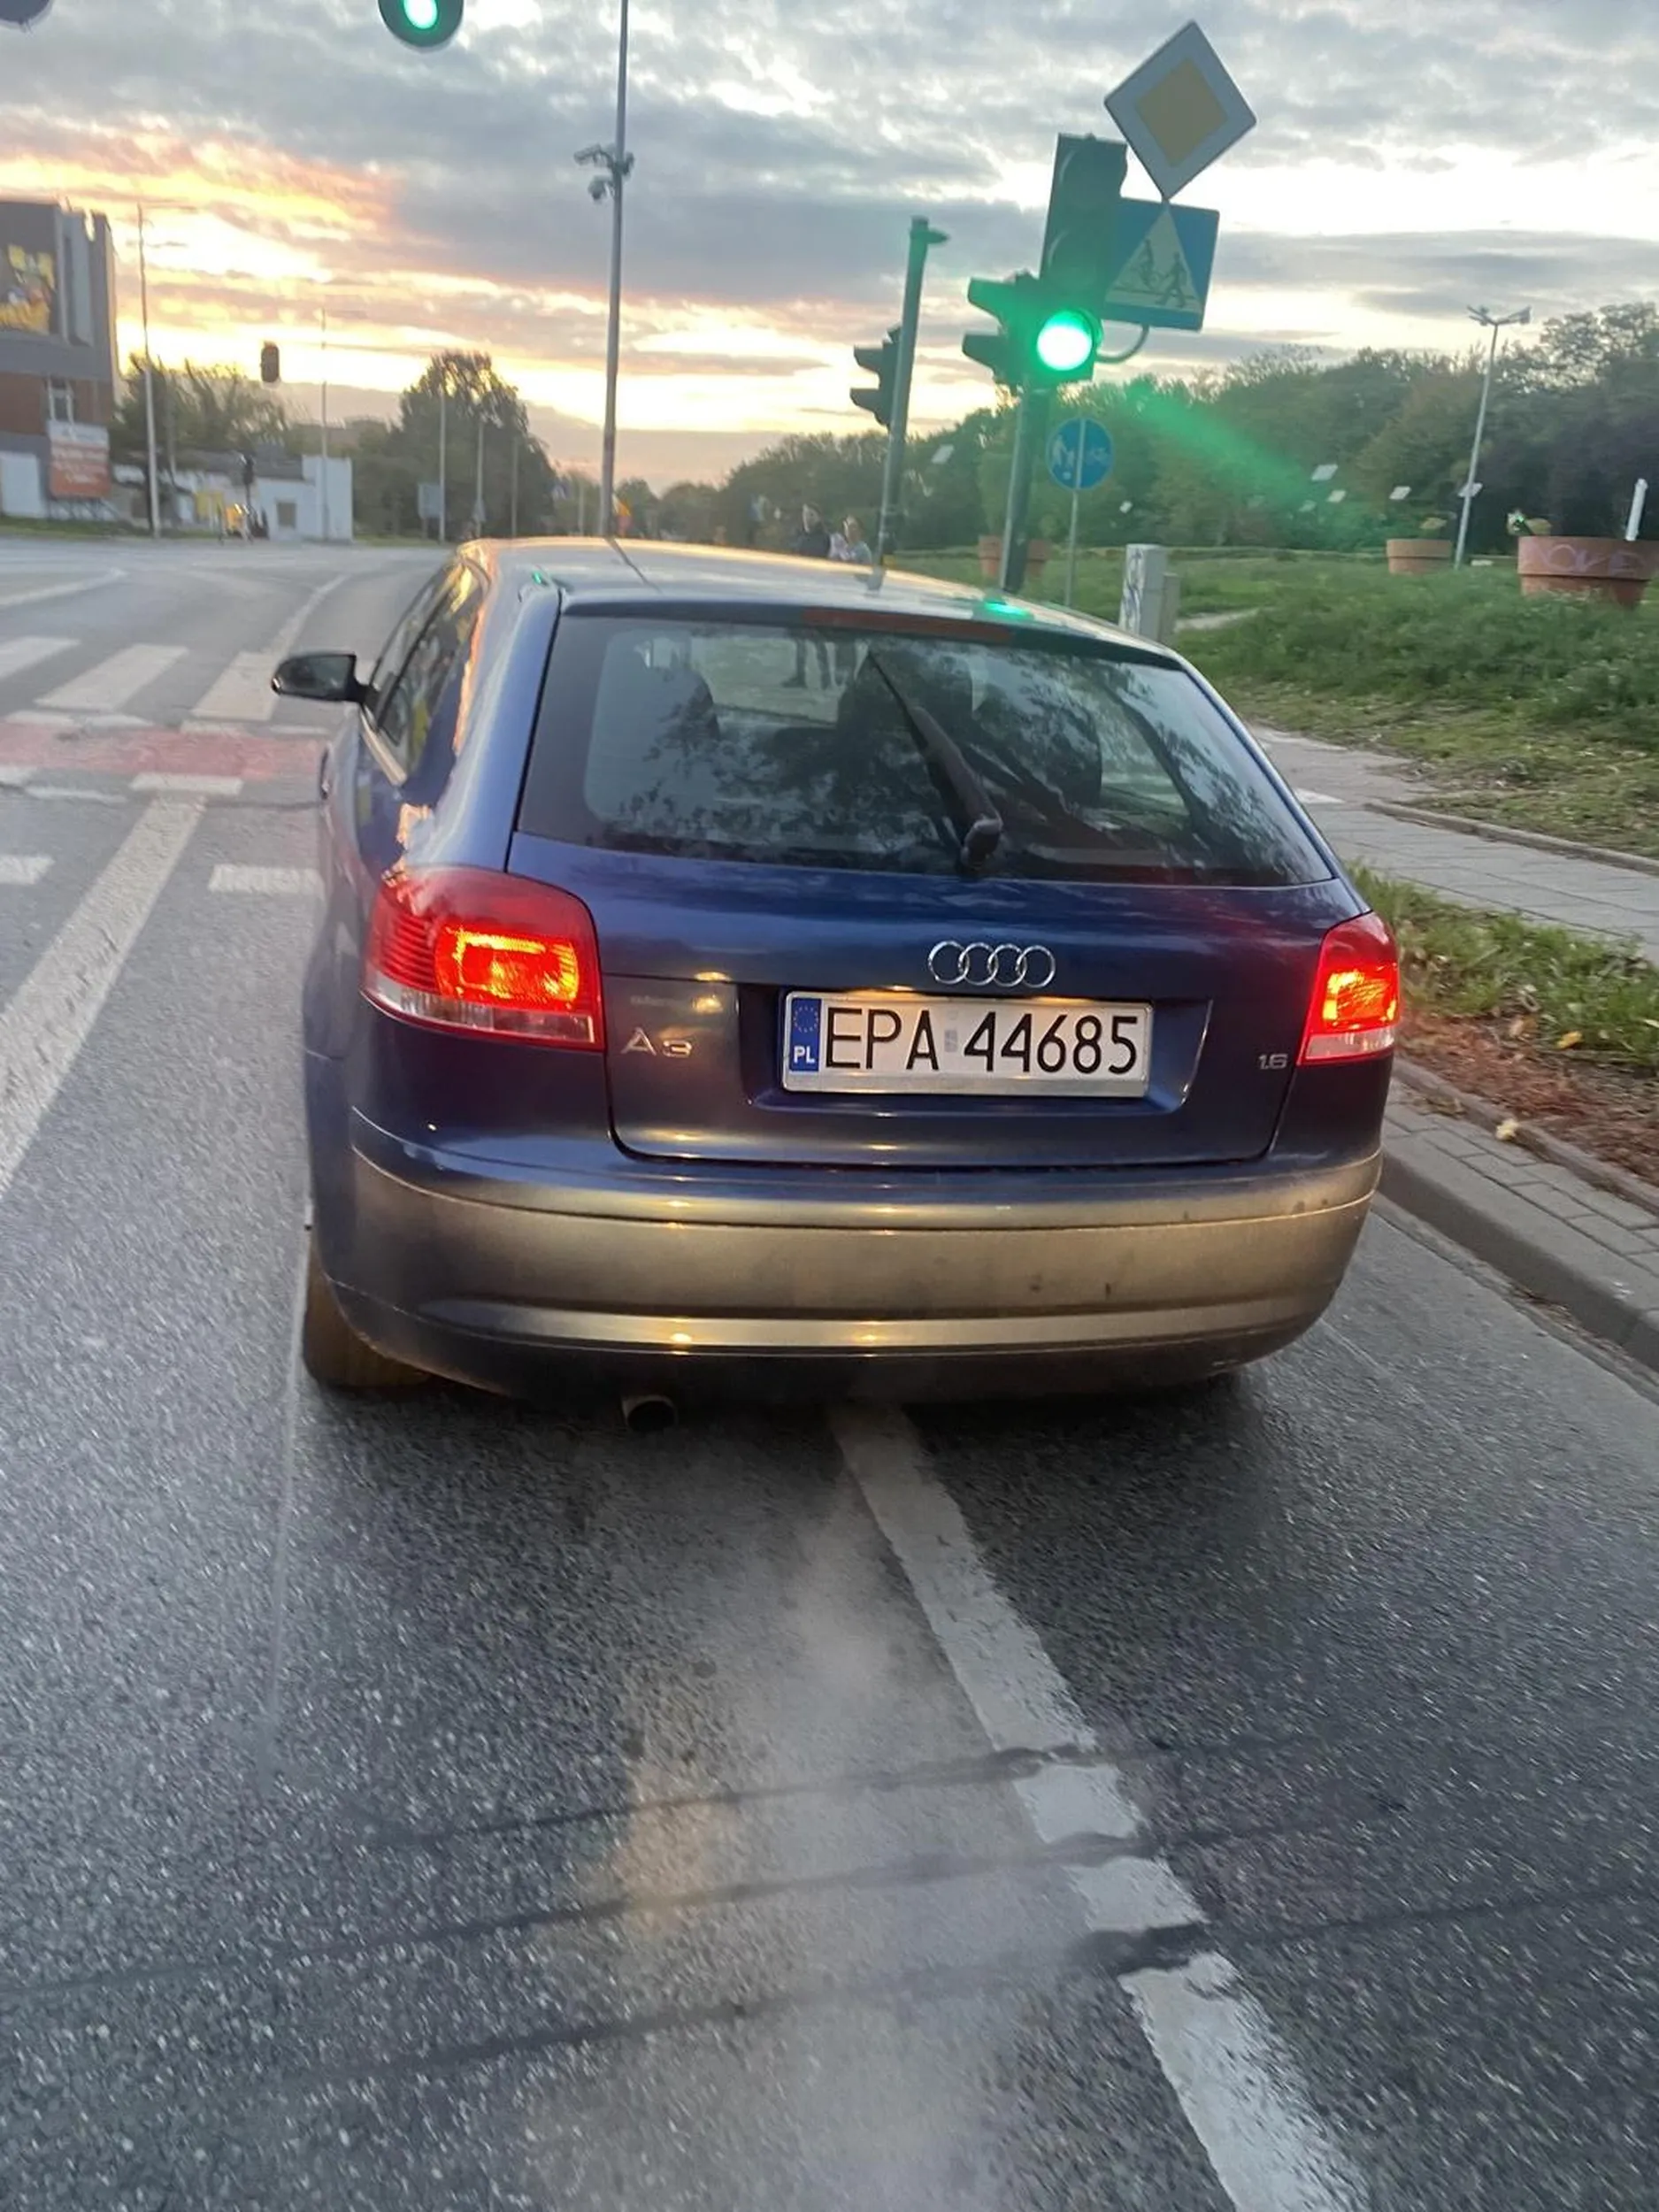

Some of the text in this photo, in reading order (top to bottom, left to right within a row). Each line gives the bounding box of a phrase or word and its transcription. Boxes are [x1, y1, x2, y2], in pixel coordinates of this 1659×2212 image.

[620, 1026, 692, 1058] A3
[794, 1046, 816, 1064] PL
[826, 1007, 1138, 1074] EPA 44685
